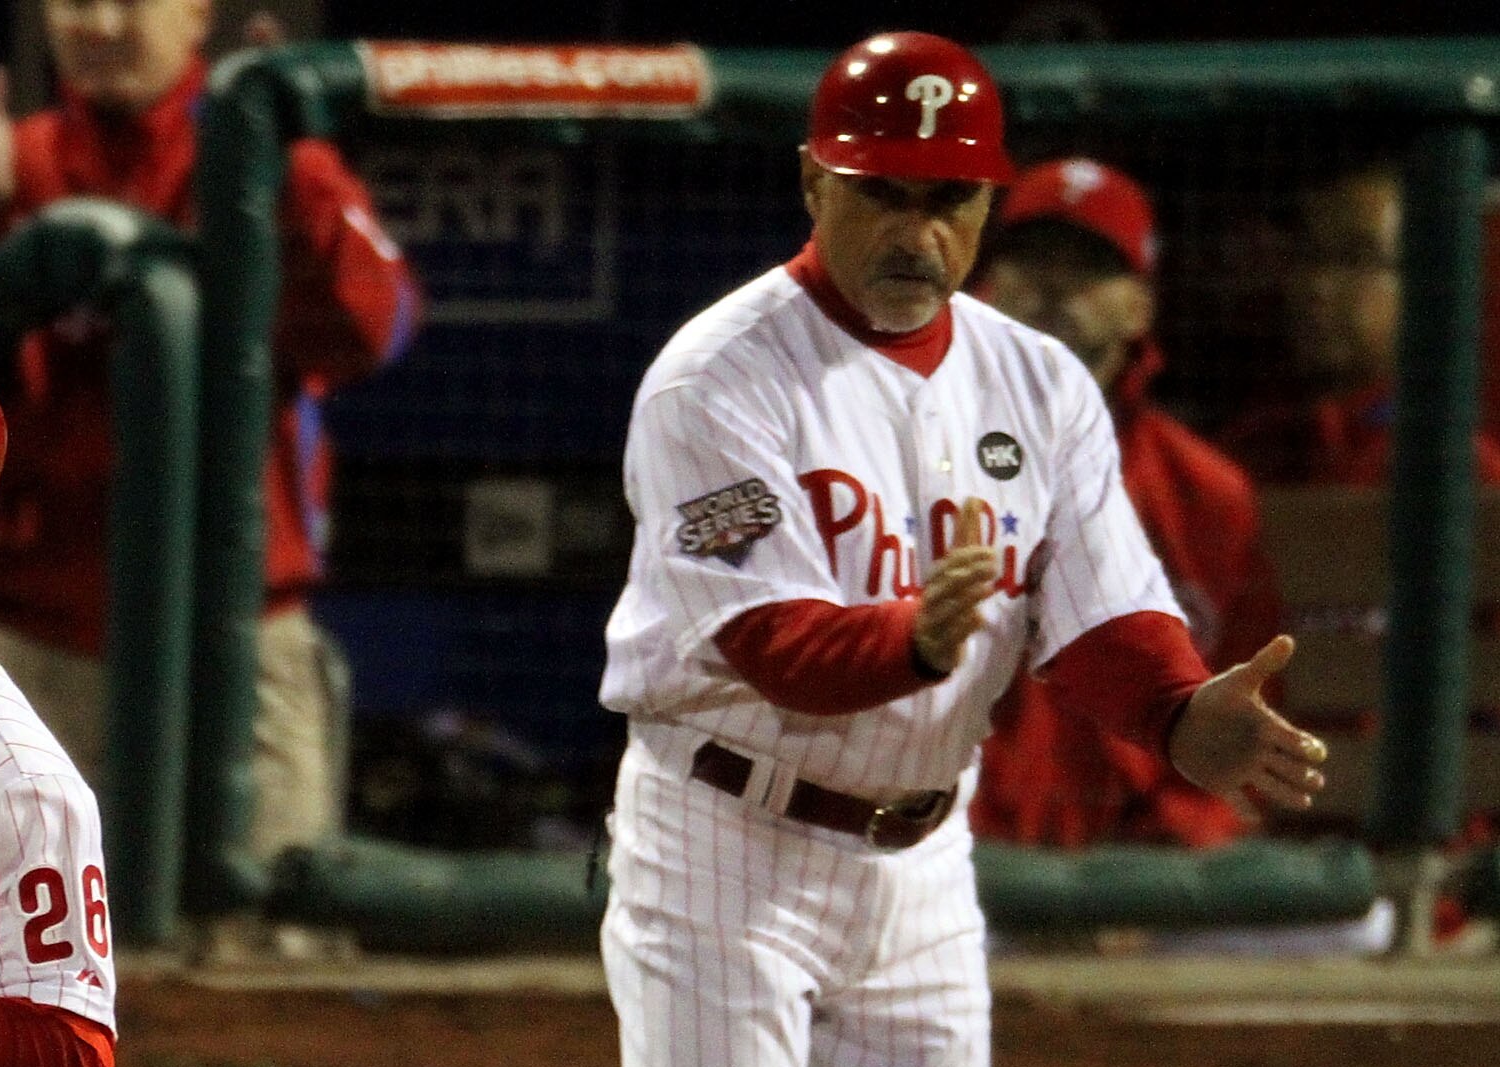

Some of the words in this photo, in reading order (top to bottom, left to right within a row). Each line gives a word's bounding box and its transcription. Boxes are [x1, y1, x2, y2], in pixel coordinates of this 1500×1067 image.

[905, 74, 953, 139] P
[982, 444, 1019, 468] HK
[678, 497, 781, 552] SERIES
[681, 481, 764, 519] WORLD
[18, 864, 109, 965] 26
